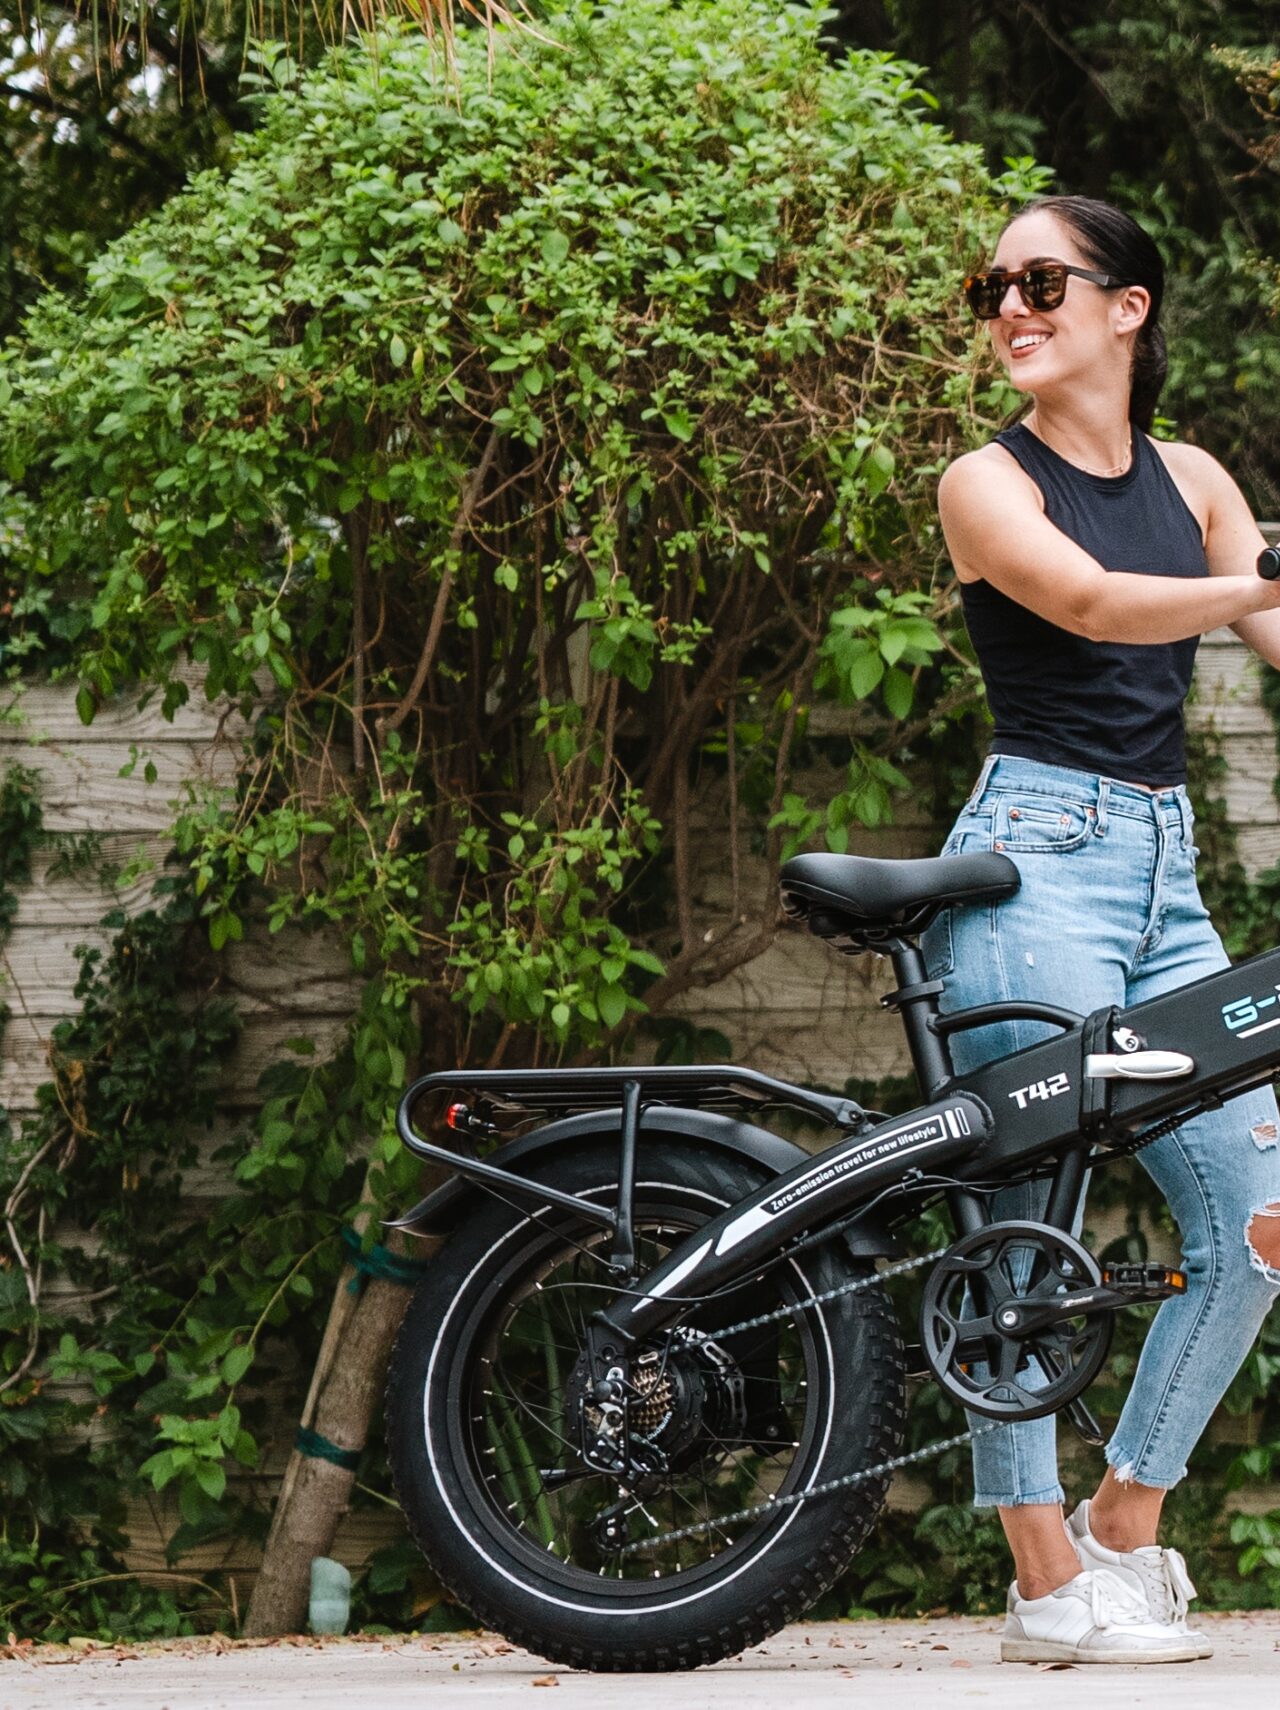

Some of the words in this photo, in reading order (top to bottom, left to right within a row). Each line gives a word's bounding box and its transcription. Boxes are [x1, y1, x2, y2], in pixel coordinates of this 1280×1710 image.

[1008, 1072, 1071, 1109] T42
[771, 1169, 836, 1211] Zero-emission
[834, 1154, 864, 1173] travel
[862, 1149, 877, 1160] for
[877, 1140, 898, 1154] new
[897, 1126, 937, 1146] lifestyle
